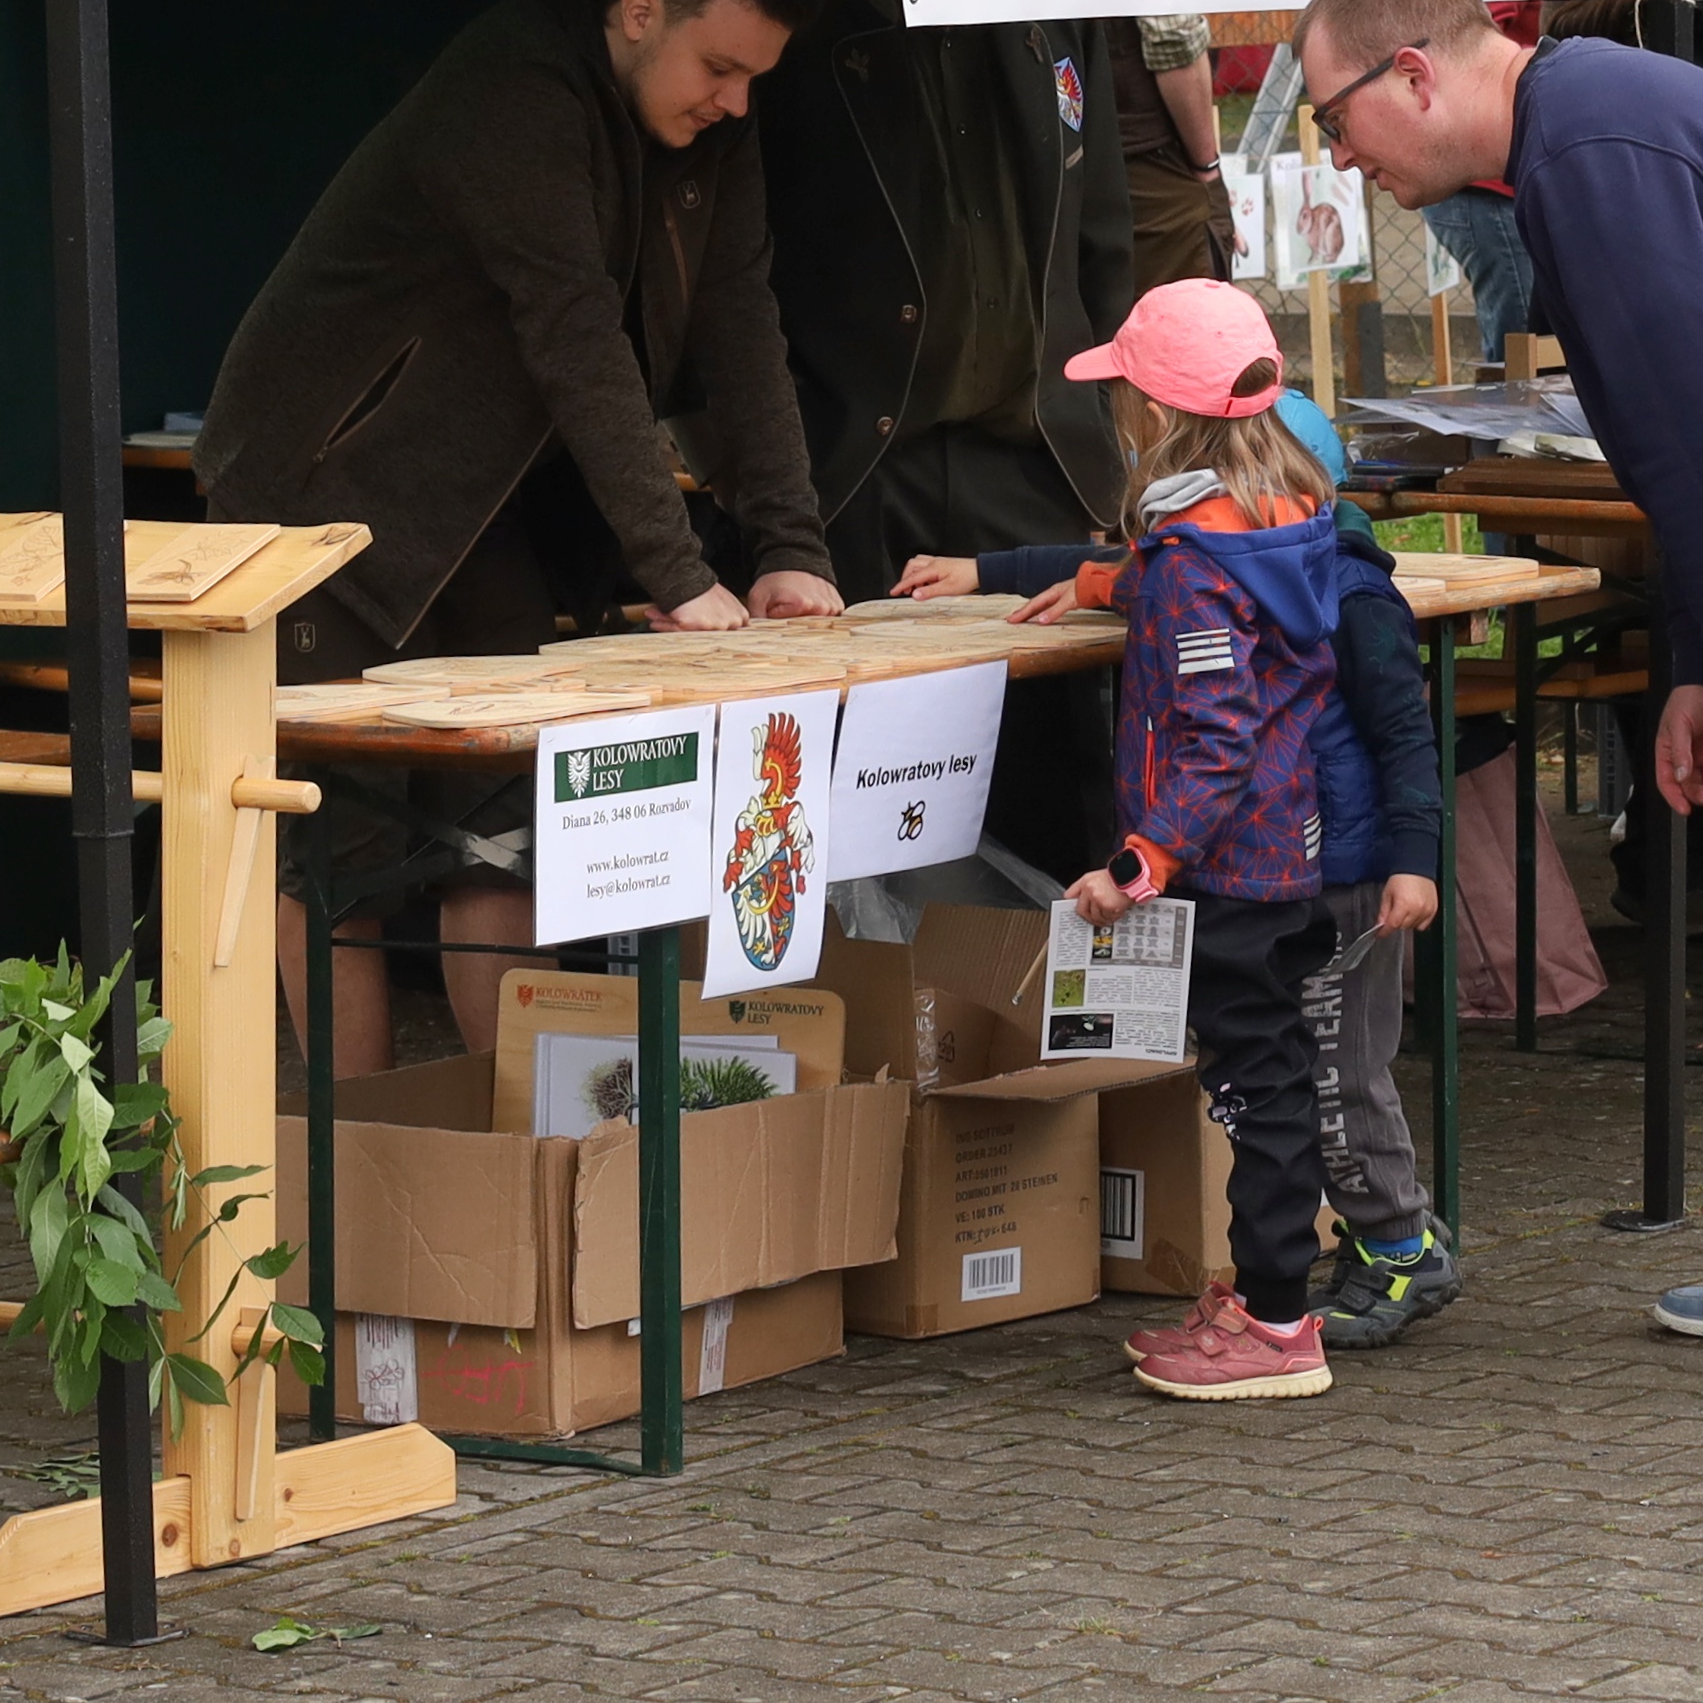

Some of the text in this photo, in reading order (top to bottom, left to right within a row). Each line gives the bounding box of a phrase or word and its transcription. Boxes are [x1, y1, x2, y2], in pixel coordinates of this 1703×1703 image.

[593, 736, 687, 768] KOLOWRATOVY
[593, 769, 624, 792] LESY
[856, 754, 977, 790] Kolowratovy lesy
[562, 797, 691, 830] Diana 26, 348 06 Rozvadov
[586, 851, 669, 874] www.kolowrat.cz
[587, 875, 671, 899] lesy@kolowrat.cz
[747, 1012, 772, 1025] LESY
[748, 1001, 825, 1017] KOLOWRATOVY
[955, 1186, 991, 1203] DOMINO
[991, 1182, 1007, 1196] MIT
[1021, 1172, 1059, 1190] STEINEN
[955, 1211, 970, 1223] VE:
[987, 1203, 1005, 1217] STK
